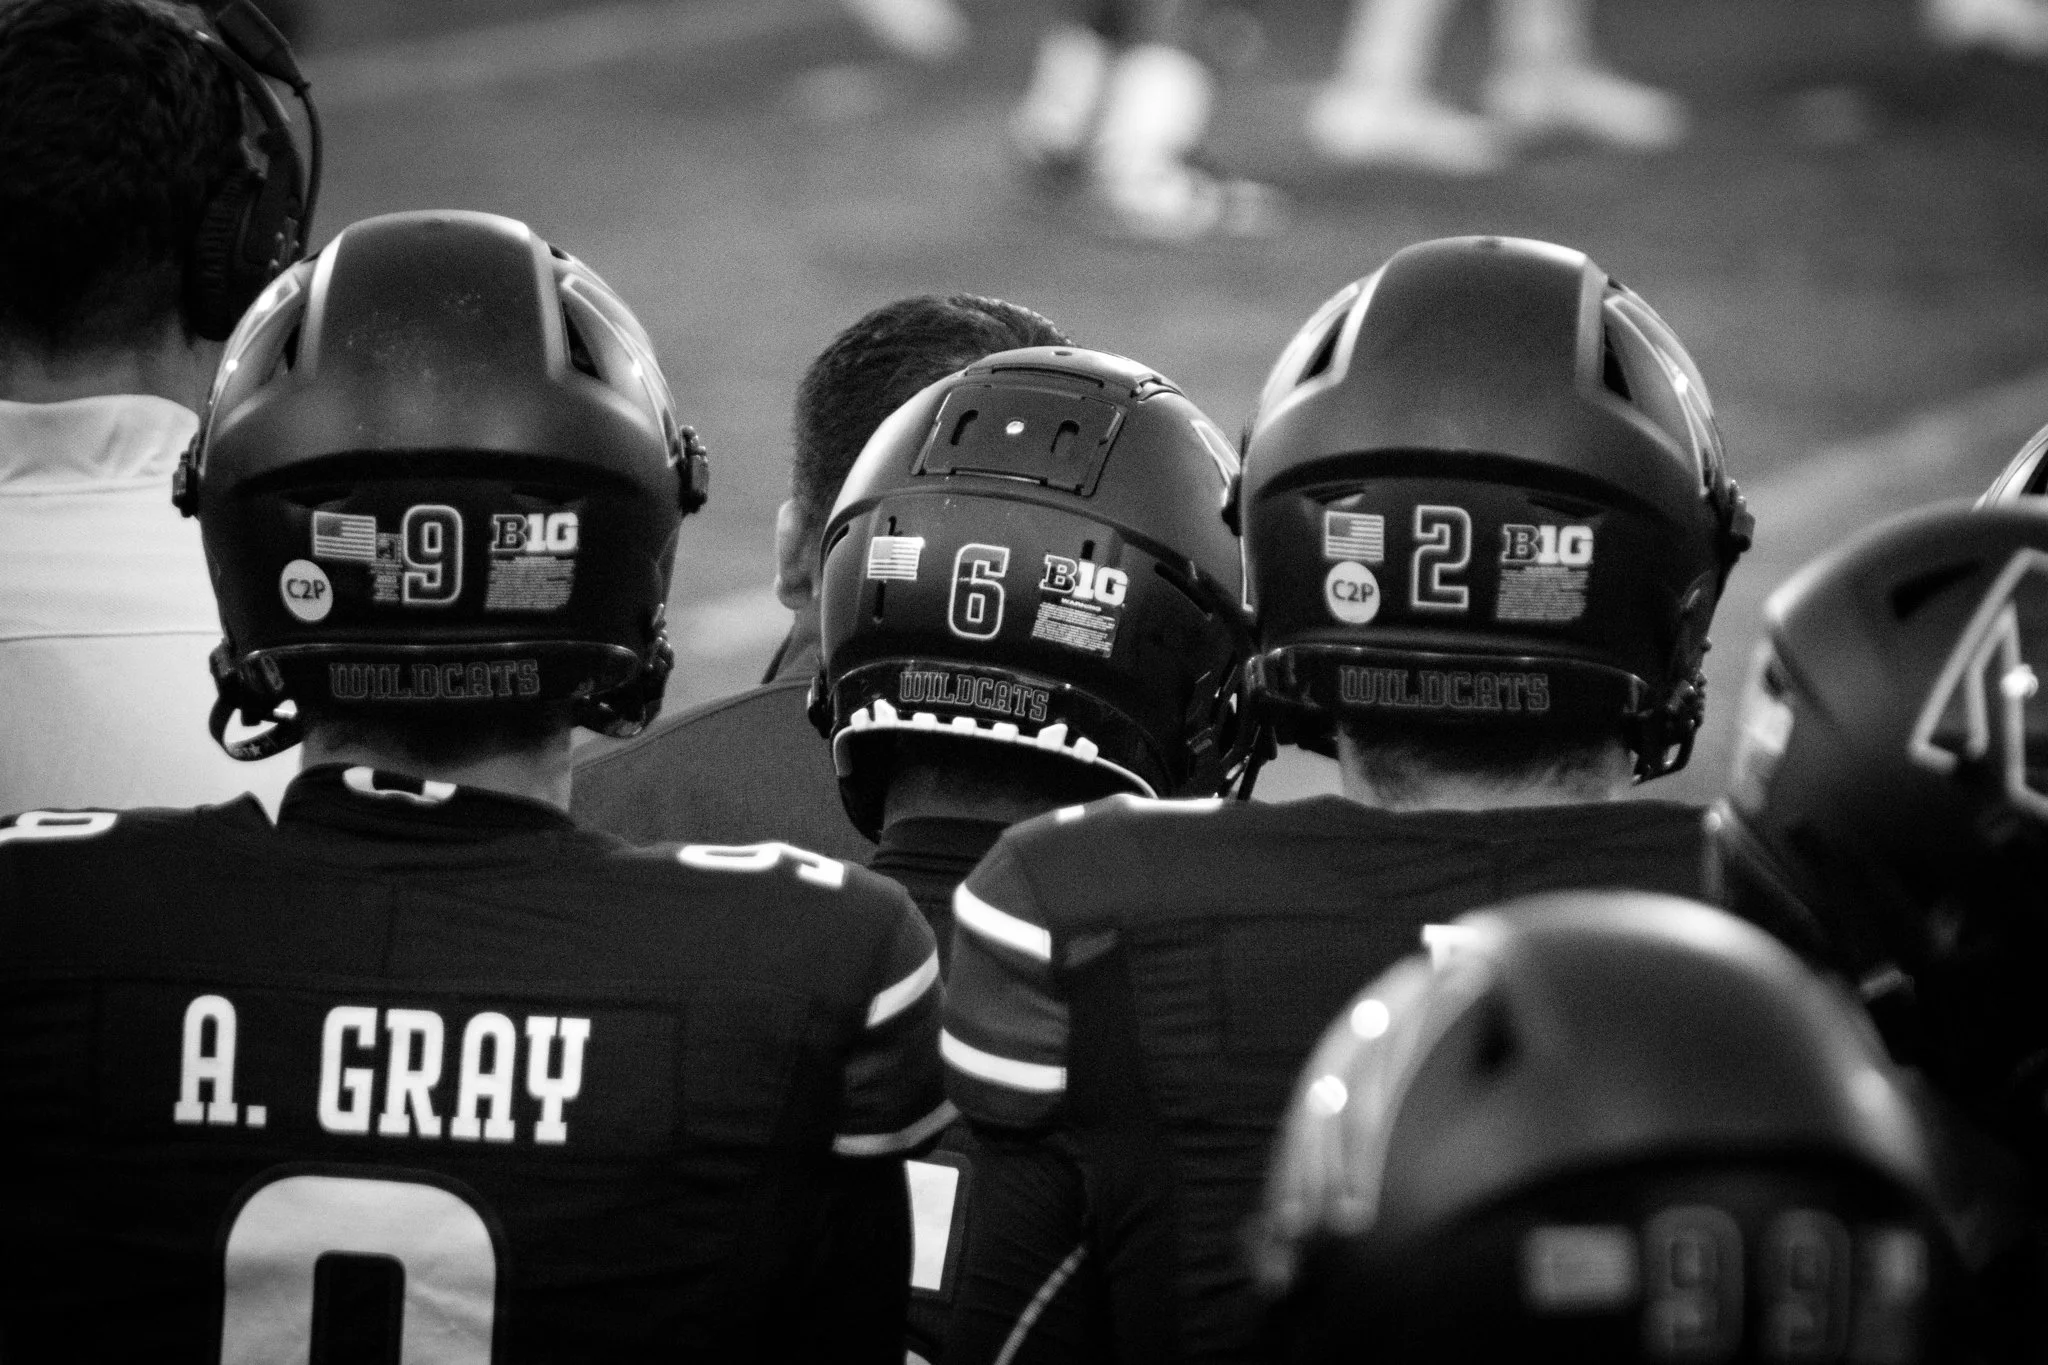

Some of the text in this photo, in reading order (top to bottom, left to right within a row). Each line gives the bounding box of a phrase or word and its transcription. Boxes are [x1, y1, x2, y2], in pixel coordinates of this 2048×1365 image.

[403, 504, 463, 603] 9
[1411, 504, 1472, 610] 2
[285, 578, 326, 600] C2P
[948, 543, 1010, 640] 6
[1331, 578, 1375, 603] C2P
[329, 659, 540, 699] WILDCATS
[899, 670, 1050, 722] WILDCATS
[1339, 665, 1550, 710] WILDCATS
[174, 994, 590, 1144] A. GRAY
